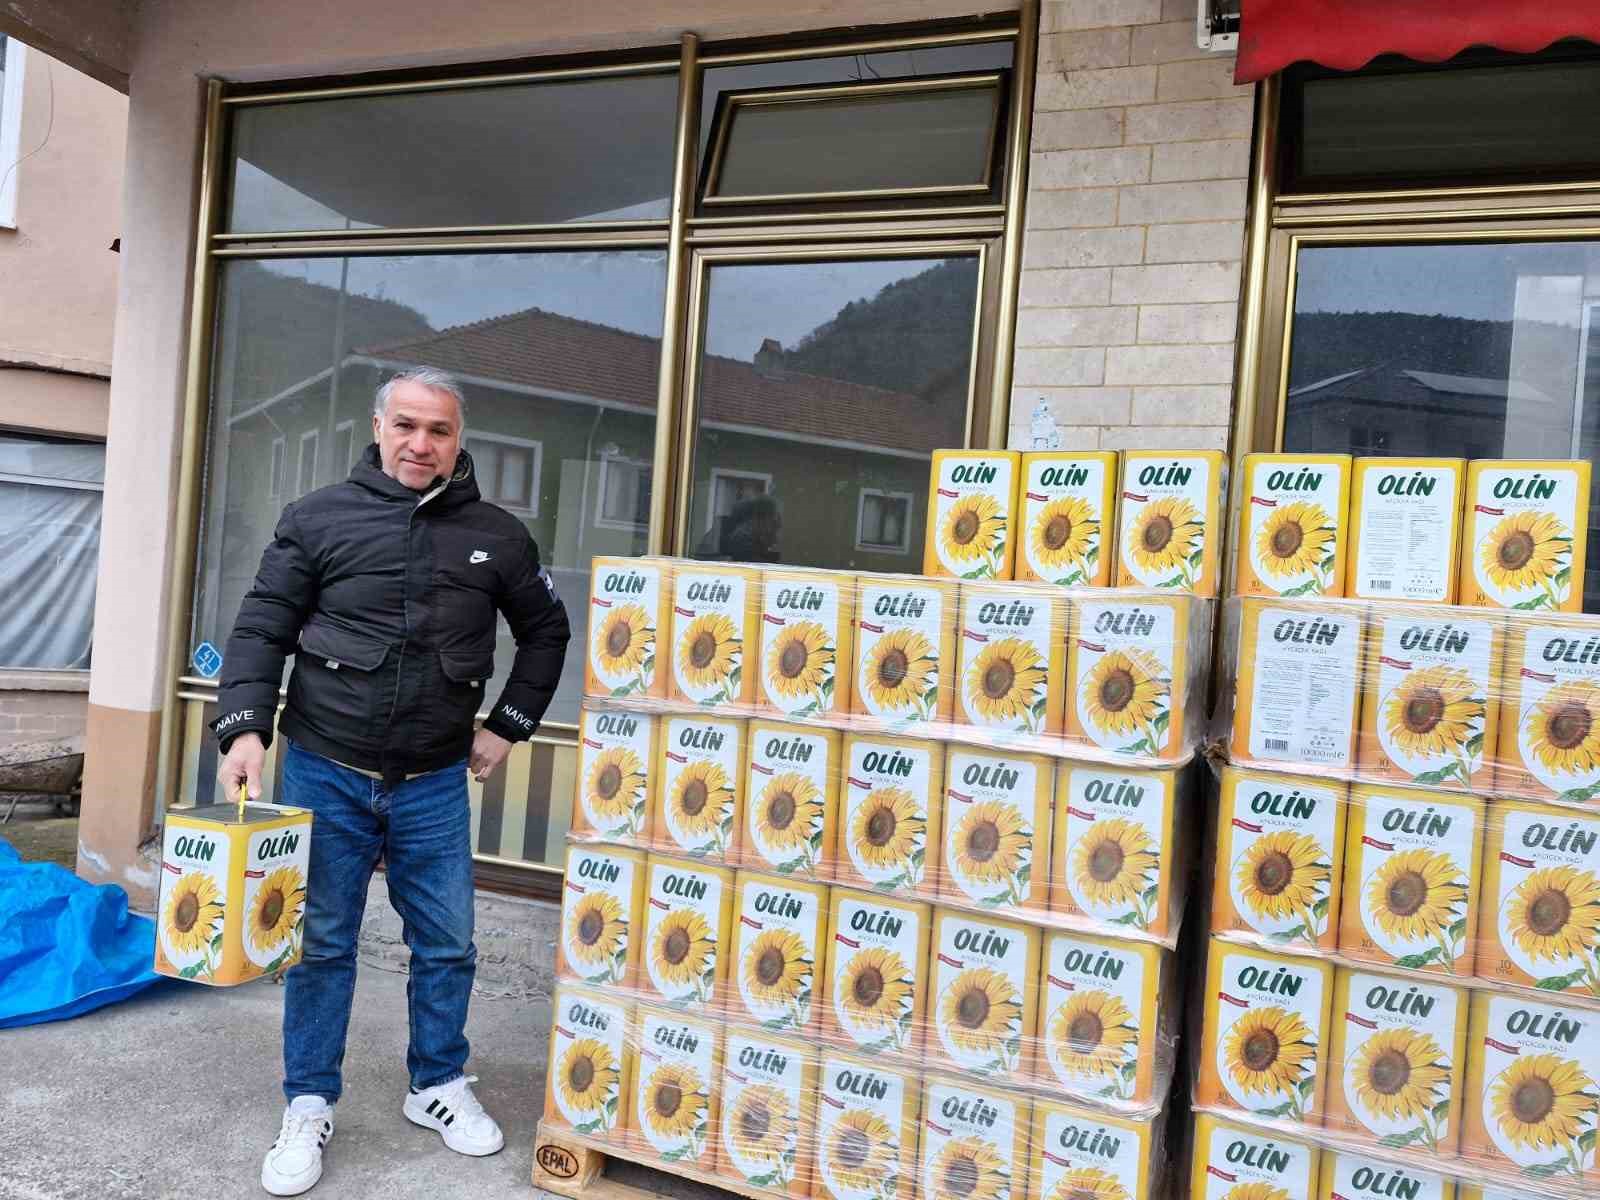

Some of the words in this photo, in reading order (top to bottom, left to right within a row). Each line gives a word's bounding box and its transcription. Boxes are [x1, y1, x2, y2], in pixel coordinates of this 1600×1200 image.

[216, 710, 254, 732] NAIVE
[502, 704, 534, 730] NAIVE
[542, 1148, 571, 1174] EPAL
